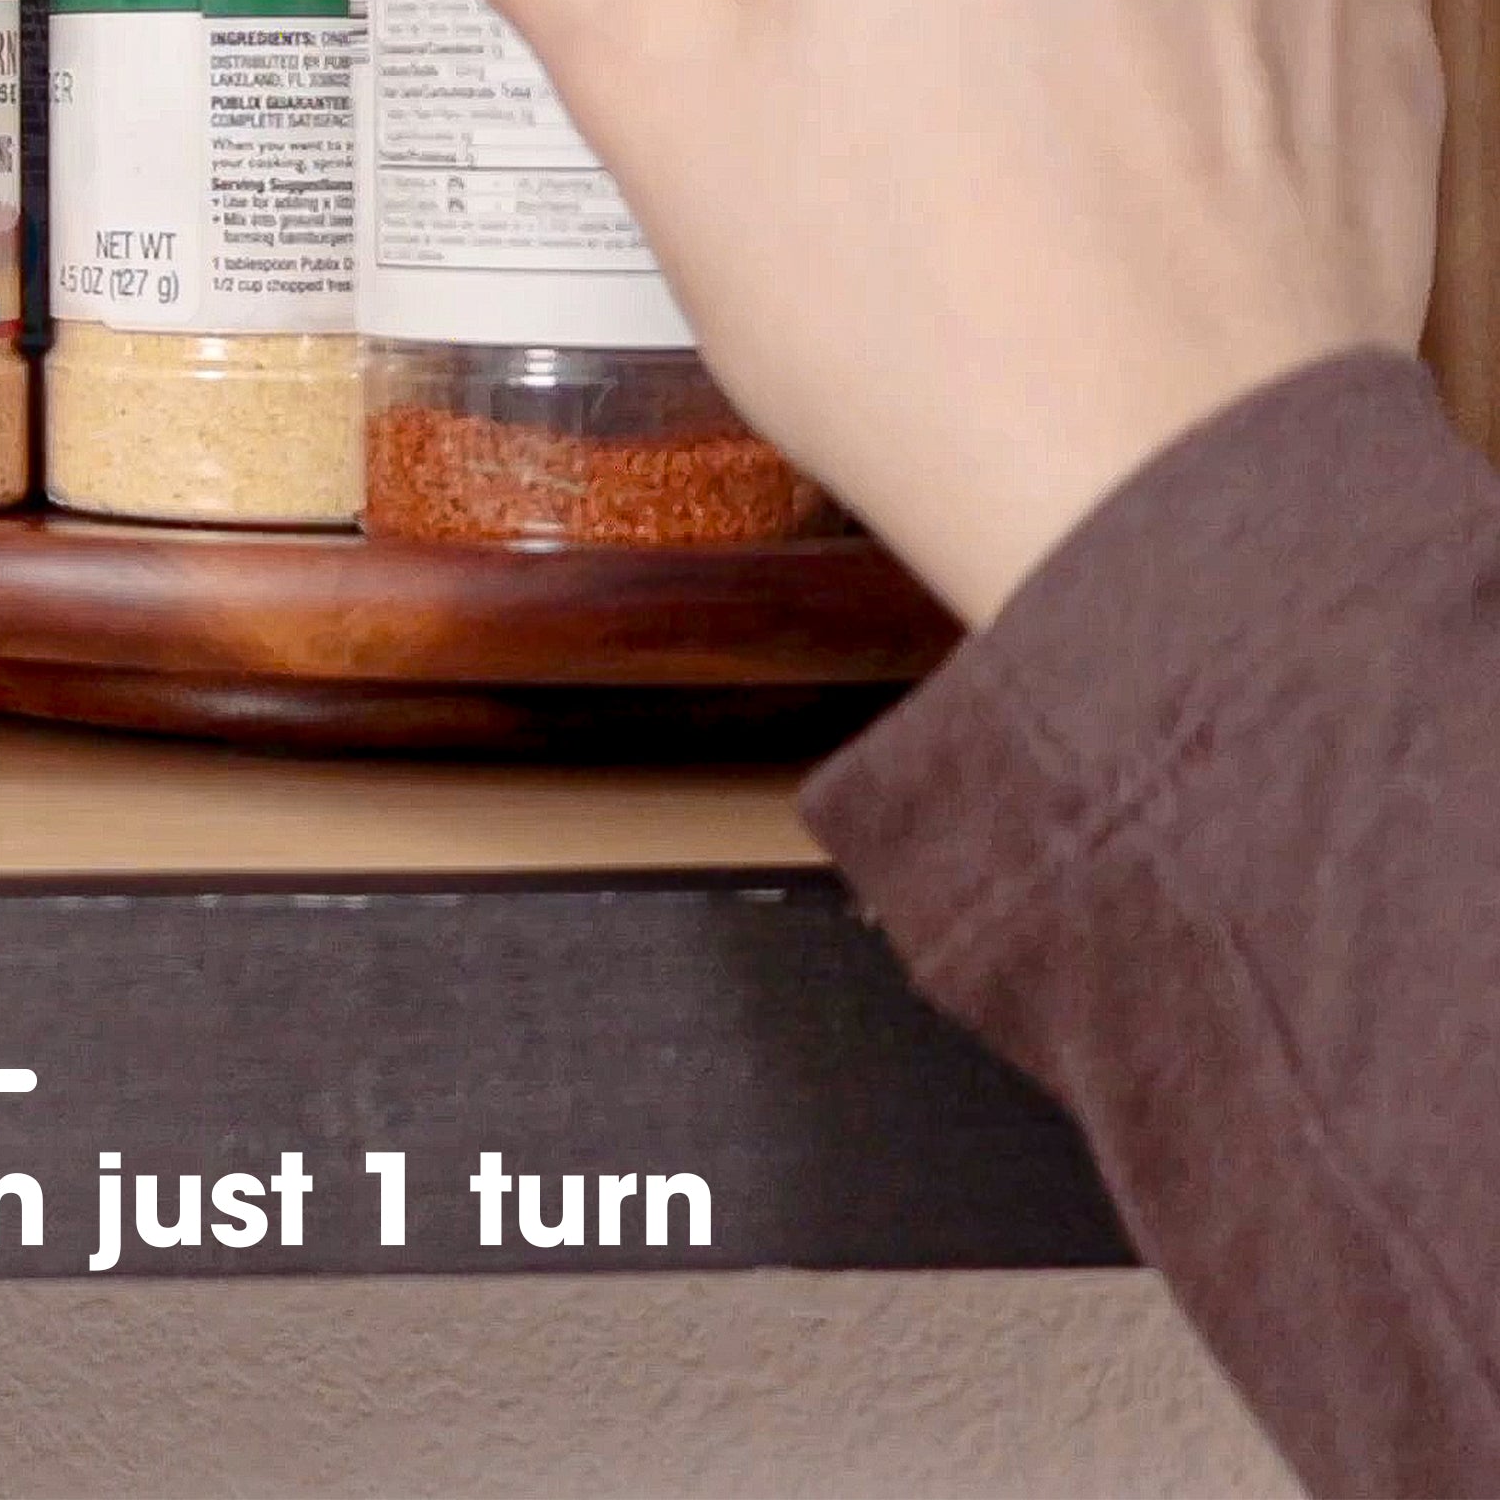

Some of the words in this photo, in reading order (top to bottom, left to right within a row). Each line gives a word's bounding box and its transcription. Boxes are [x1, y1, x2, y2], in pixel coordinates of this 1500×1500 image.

[96, 231, 133, 258] NET
[140, 232, 176, 259] WT
[81, 266, 103, 294] OZ
[110, 268, 148, 302] (127
